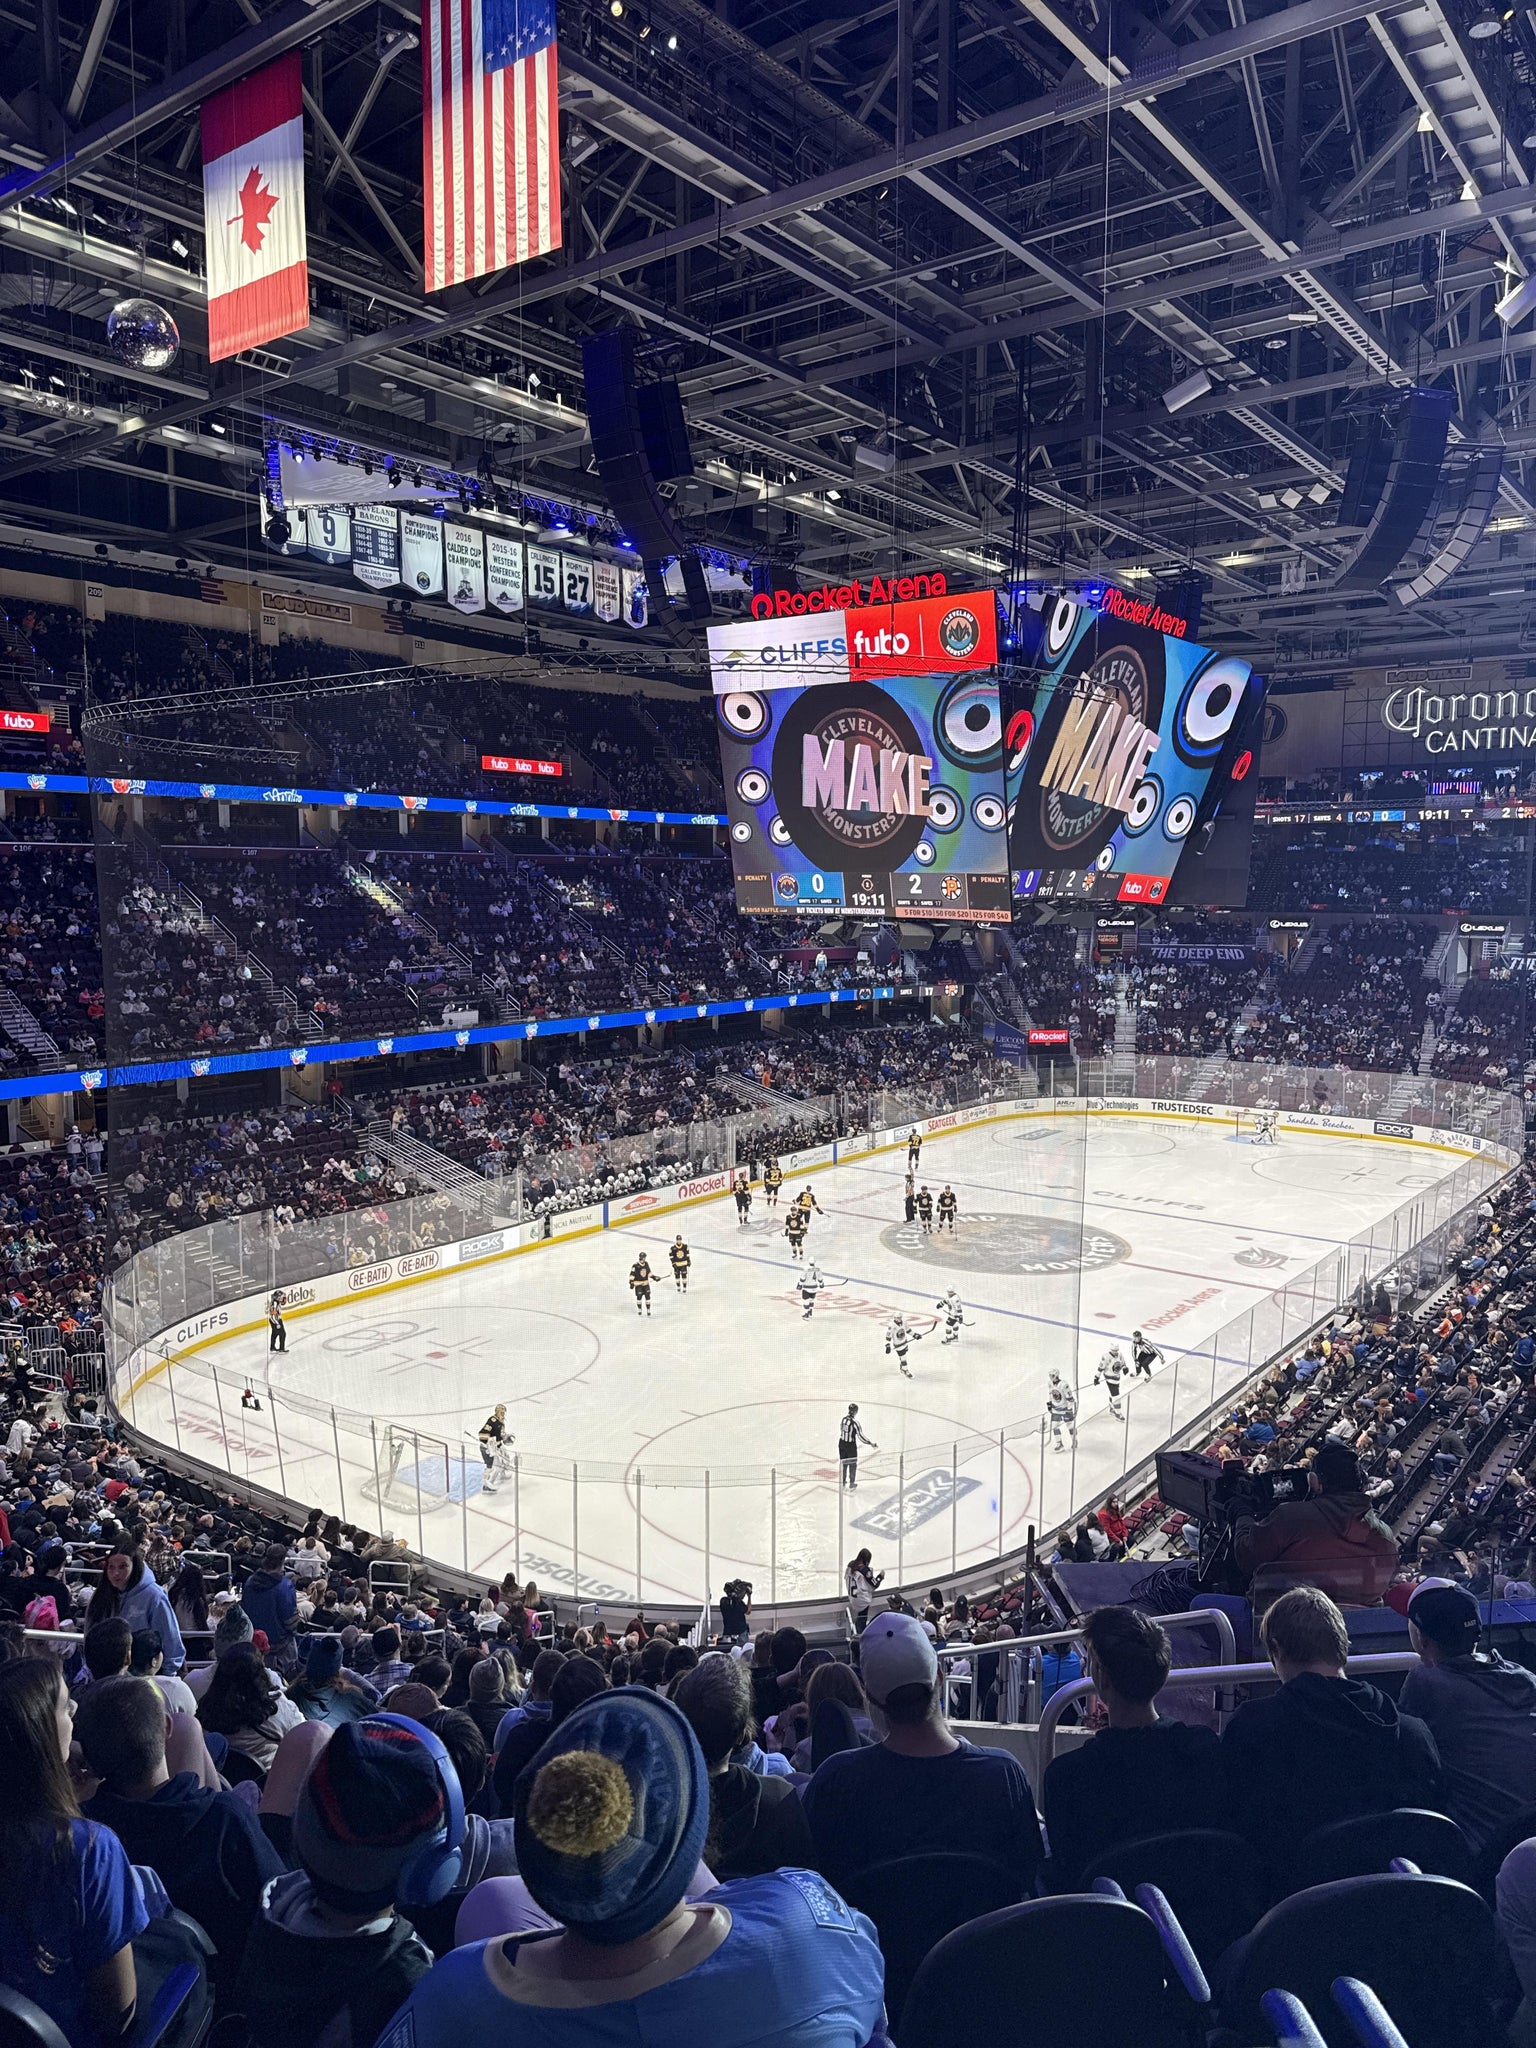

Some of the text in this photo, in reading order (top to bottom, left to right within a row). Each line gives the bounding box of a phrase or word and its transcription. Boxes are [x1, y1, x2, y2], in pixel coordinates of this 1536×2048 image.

[360, 512, 390, 525] BARONS
[322, 514, 337, 547] 9
[404, 526, 439, 542] CHAMPIONS
[455, 531, 472, 543] 2016
[446, 542, 482, 558] CALDER CUP
[491, 542, 518, 557] 2015-16
[447, 553, 482, 569] CHAMPIONS
[492, 555, 518, 568] WESTERN
[360, 568, 393, 579] CALDER CUP
[489, 563, 521, 579] CONFERENCE
[490, 575, 521, 589] CHAMPIONS
[534, 563, 555, 595] 15
[88, 587, 103, 597] 209
[567, 572, 589, 603] 27
[775, 572, 947, 617] Rocket Arena
[264, 616, 276, 625] 210
[943, 608, 974, 625] CLEVELAND
[1110, 590, 1188, 638] Rocket Arena
[760, 637, 847, 664] CLIFFS
[853, 628, 909, 659] fubo
[945, 643, 974, 656] MONSTERS
[3, 713, 35, 729] fubo
[821, 717, 901, 755] CLEVELAND
[1039, 671, 1162, 814] MAKE
[491, 757, 509, 770] fubo
[515, 759, 532, 772] fubo
[538, 761, 554, 774] fubo
[801, 733, 933, 817] MAKE
[1048, 789, 1102, 839] MONSTERS
[1294, 814, 1306, 823] 17
[1336, 813, 1342, 822] 4
[1381, 811, 1389, 821] 0
[1418, 809, 1450, 820] 19:11
[1501, 807, 1511, 818] 2
[822, 806, 896, 840] MONSTERS
[811, 873, 825, 894] 0
[909, 874, 923, 895] 2
[1024, 871, 1034, 889] 0
[1065, 870, 1077, 888] 2
[1038, 886, 1054, 897] 19:11
[1124, 881, 1142, 895] fubo
[851, 893, 885, 906] 19:11
[935, 909, 944, 917] 50
[972, 911, 983, 919] 125
[997, 912, 1009, 920] $40
[1151, 947, 1245, 961] THE DEEP END
[1509, 956, 1536, 970] THE
[882, 989, 888, 997] 4
[925, 987, 934, 996] 17
[995, 1036, 1025, 1045] LECOM
[1038, 1032, 1066, 1041] Rocket
[1086, 1100, 1139, 1111] Blue Technologies
[1151, 1101, 1214, 1116] TRUSTEDSEC
[927, 1114, 958, 1133] SEATGEEK
[1376, 1123, 1406, 1136] ROCK
[688, 1175, 726, 1198] Rocket
[1092, 1190, 1207, 1211] CLIFFS
[462, 1237, 493, 1255] ROCK
[1020, 1235, 1116, 1273] MONSTERS
[287, 1288, 310, 1306] delo
[1151, 1287, 1224, 1327] Rocket Arena
[177, 1311, 229, 1343] CLIFFS
[1463, 1619, 1477, 1628] EAST
